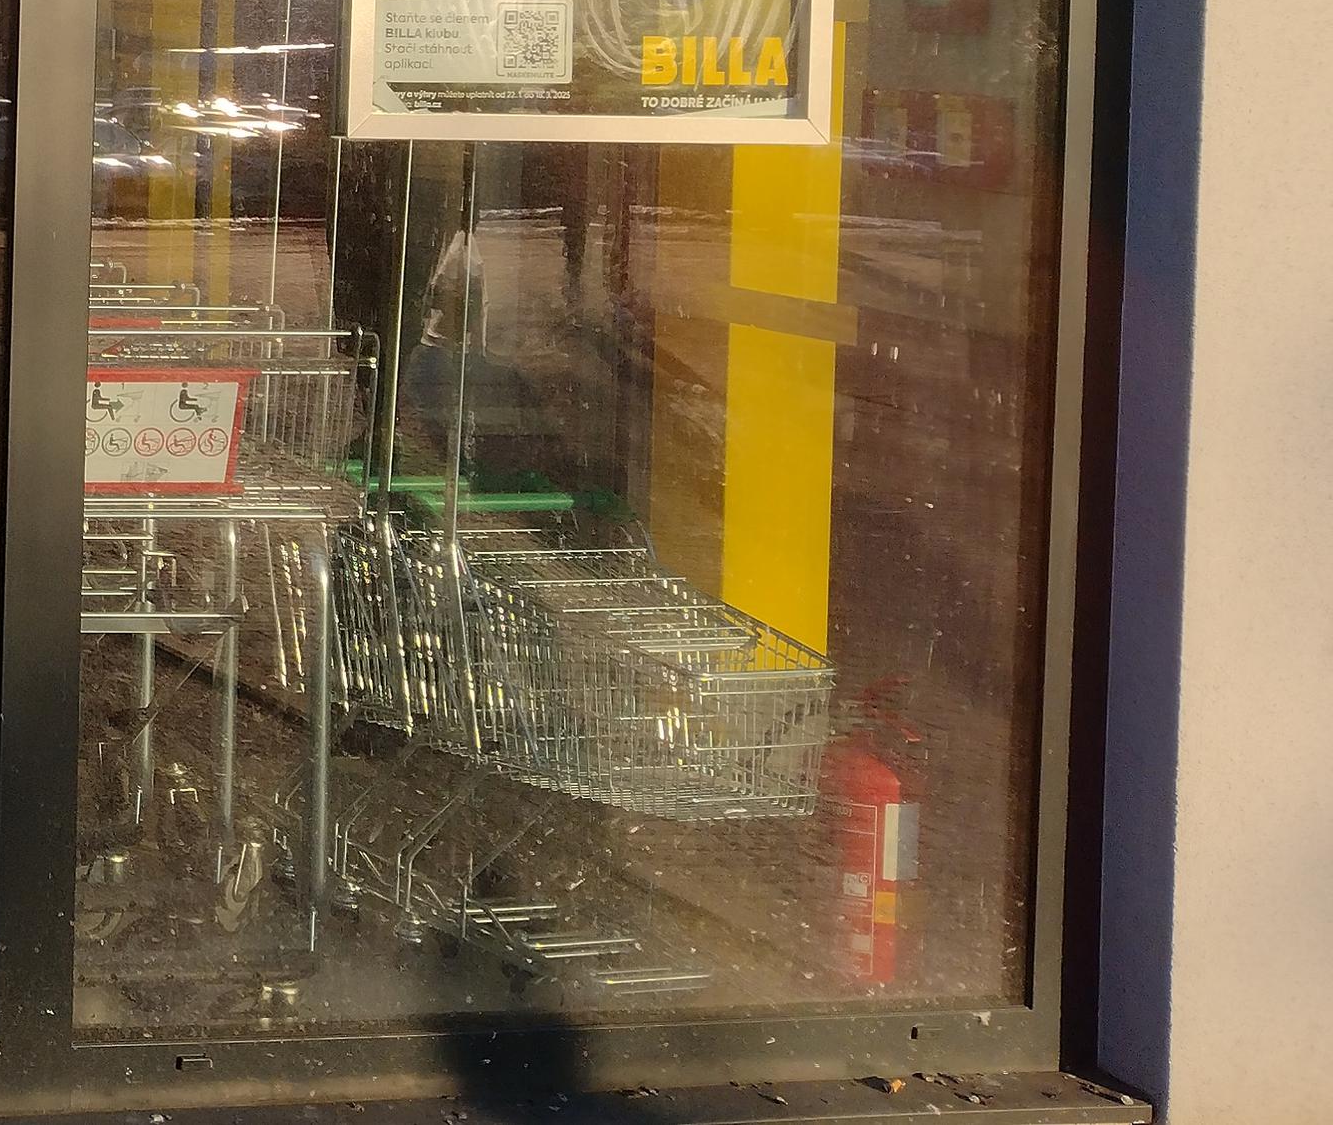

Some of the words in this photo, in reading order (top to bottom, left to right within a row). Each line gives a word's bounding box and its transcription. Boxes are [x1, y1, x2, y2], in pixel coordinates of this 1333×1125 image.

[386, 13, 426, 24] Staňte
[430, 15, 442, 24] se
[386, 28, 421, 38] BILLA
[385, 43, 416, 53] Stačí
[420, 44, 473, 55] stáhnout
[642, 36, 789, 85] BILLA
[641, 97, 659, 107] TO
[661, 94, 704, 108] DOBRÉ
